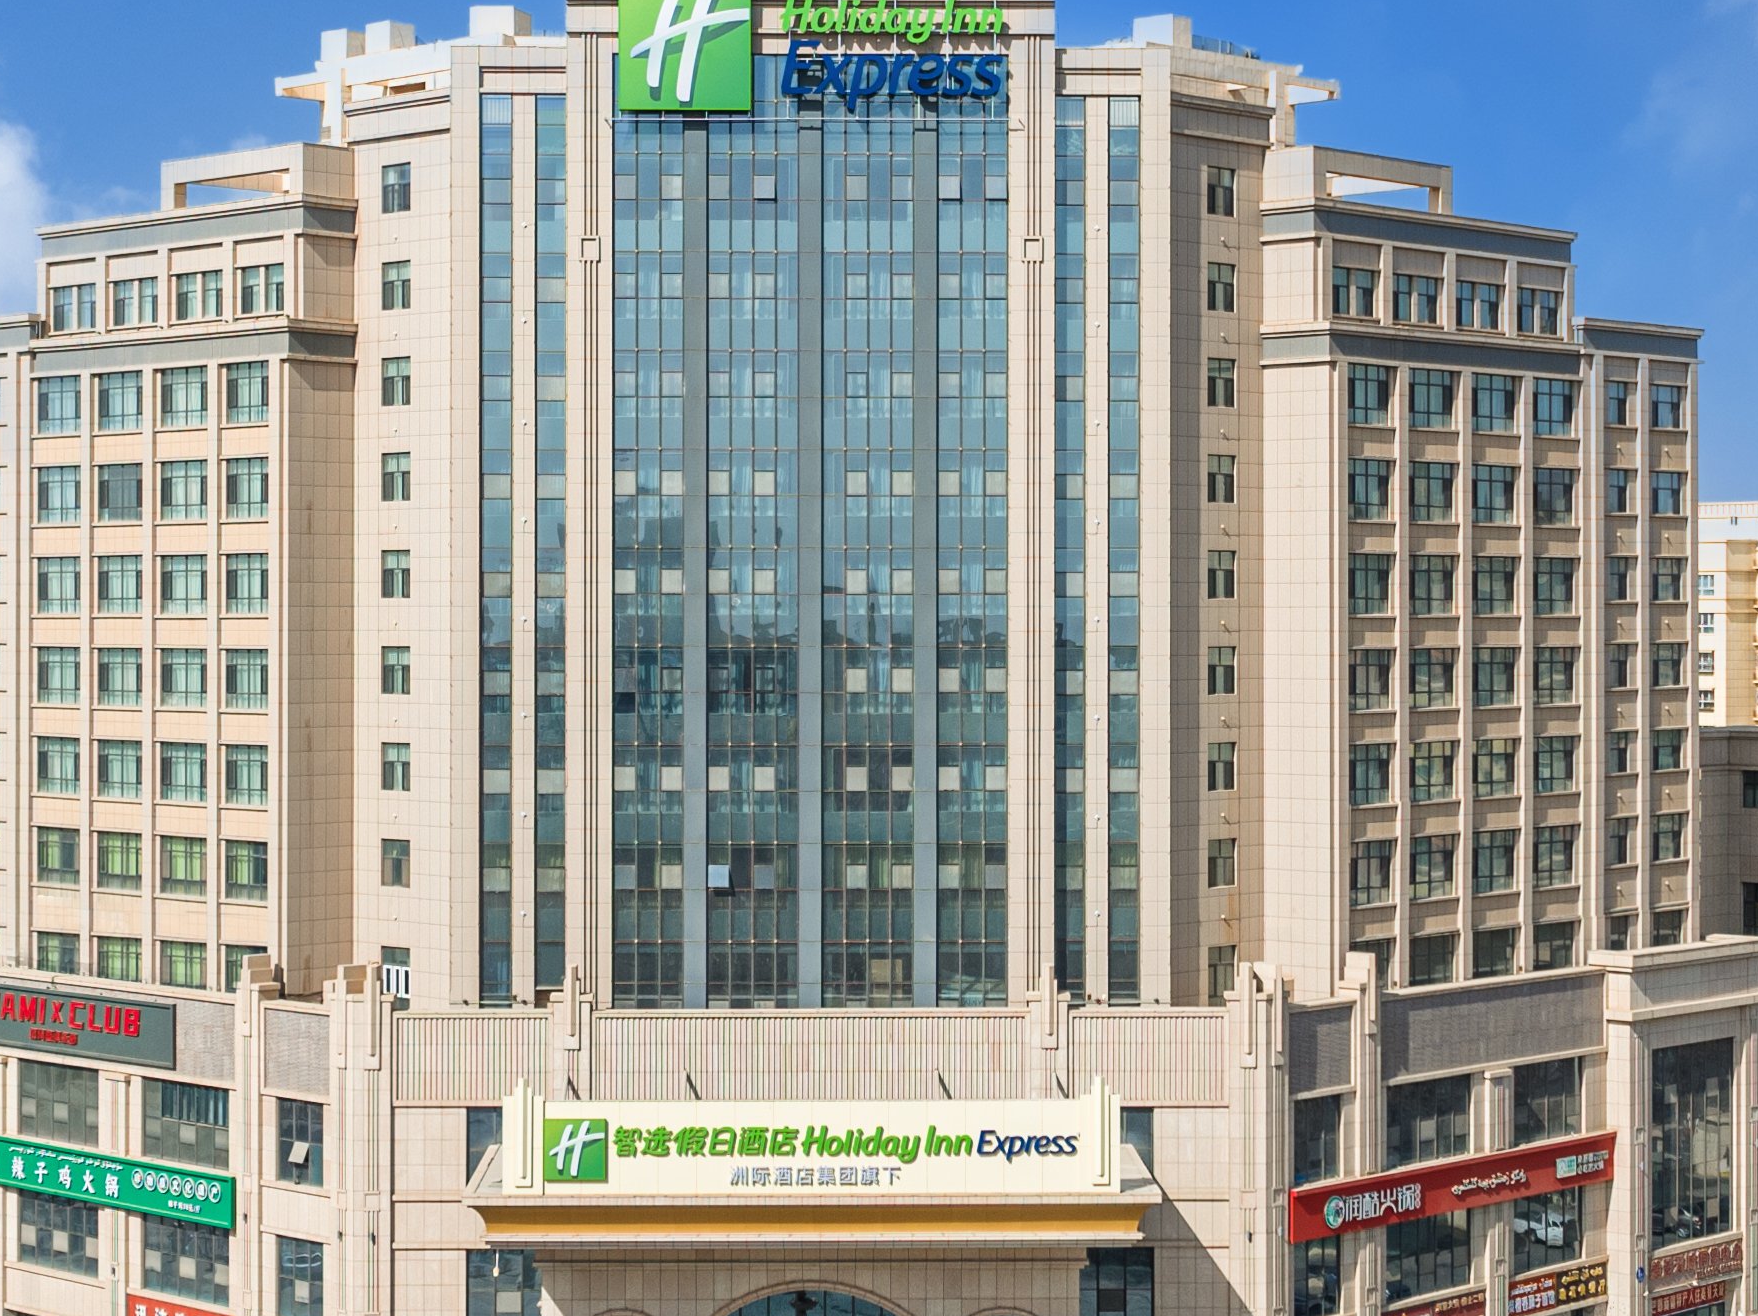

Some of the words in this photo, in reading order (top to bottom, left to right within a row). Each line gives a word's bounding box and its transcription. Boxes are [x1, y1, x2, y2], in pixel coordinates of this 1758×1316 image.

[781, 40, 1003, 112] Express
[68, 1001, 142, 1037] CLUB
[612, 1125, 800, 1157] 智选假日酒店
[801, 1125, 920, 1163] Holiday
[925, 1125, 973, 1156] Inn
[977, 1130, 1078, 1163] Express
[11, 1156, 120, 1199] 辣子鸡火锅
[730, 1166, 902, 1186] 洲际酒店集团旗下
[1345, 1183, 1415, 1222] 润酷火锅
